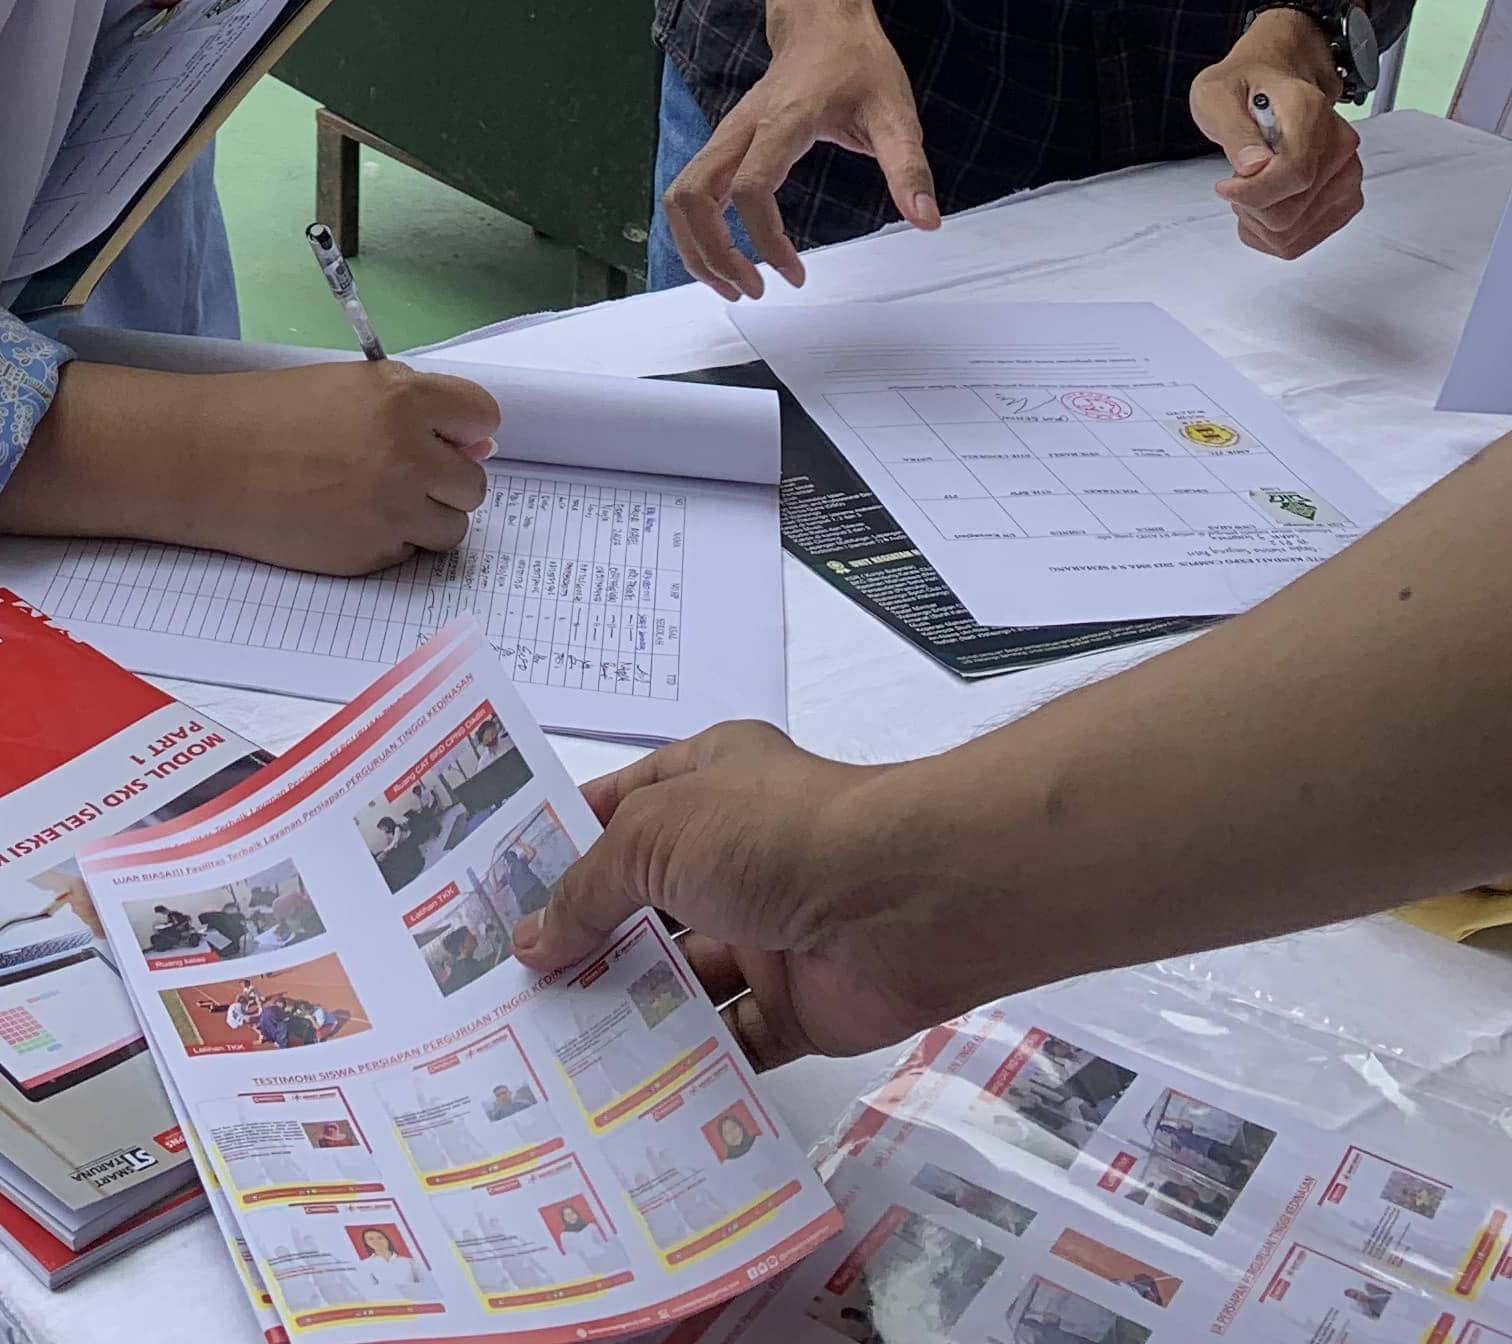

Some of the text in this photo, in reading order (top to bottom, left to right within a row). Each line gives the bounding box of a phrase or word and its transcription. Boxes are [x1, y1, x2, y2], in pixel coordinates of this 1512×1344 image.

[1179, 559, 1223, 567] CAMPUS
[129, 719, 205, 766] PART 1
[144, 732, 225, 782] MODUL
[227, 842, 262, 862] Terbaik
[263, 818, 302, 845] Layanan
[302, 786, 345, 822] Persiapan
[345, 742, 398, 789] PERGURUAN
[398, 717, 428, 746] TINGGI
[427, 672, 474, 720] KEDINASAN
[102, 778, 149, 808] SKD
[11, 801, 104, 859] (SELEKSI
[251, 1071, 317, 1087] TESTIMONI
[319, 1066, 356, 1080] SISWA
[358, 1047, 420, 1074] PERSIAPAN
[423, 1017, 490, 1053] PERGURUAN
[491, 993, 531, 1024] TINGGI
[71, 1155, 122, 1182] TARUNA
[93, 1166, 135, 1188] SMART
